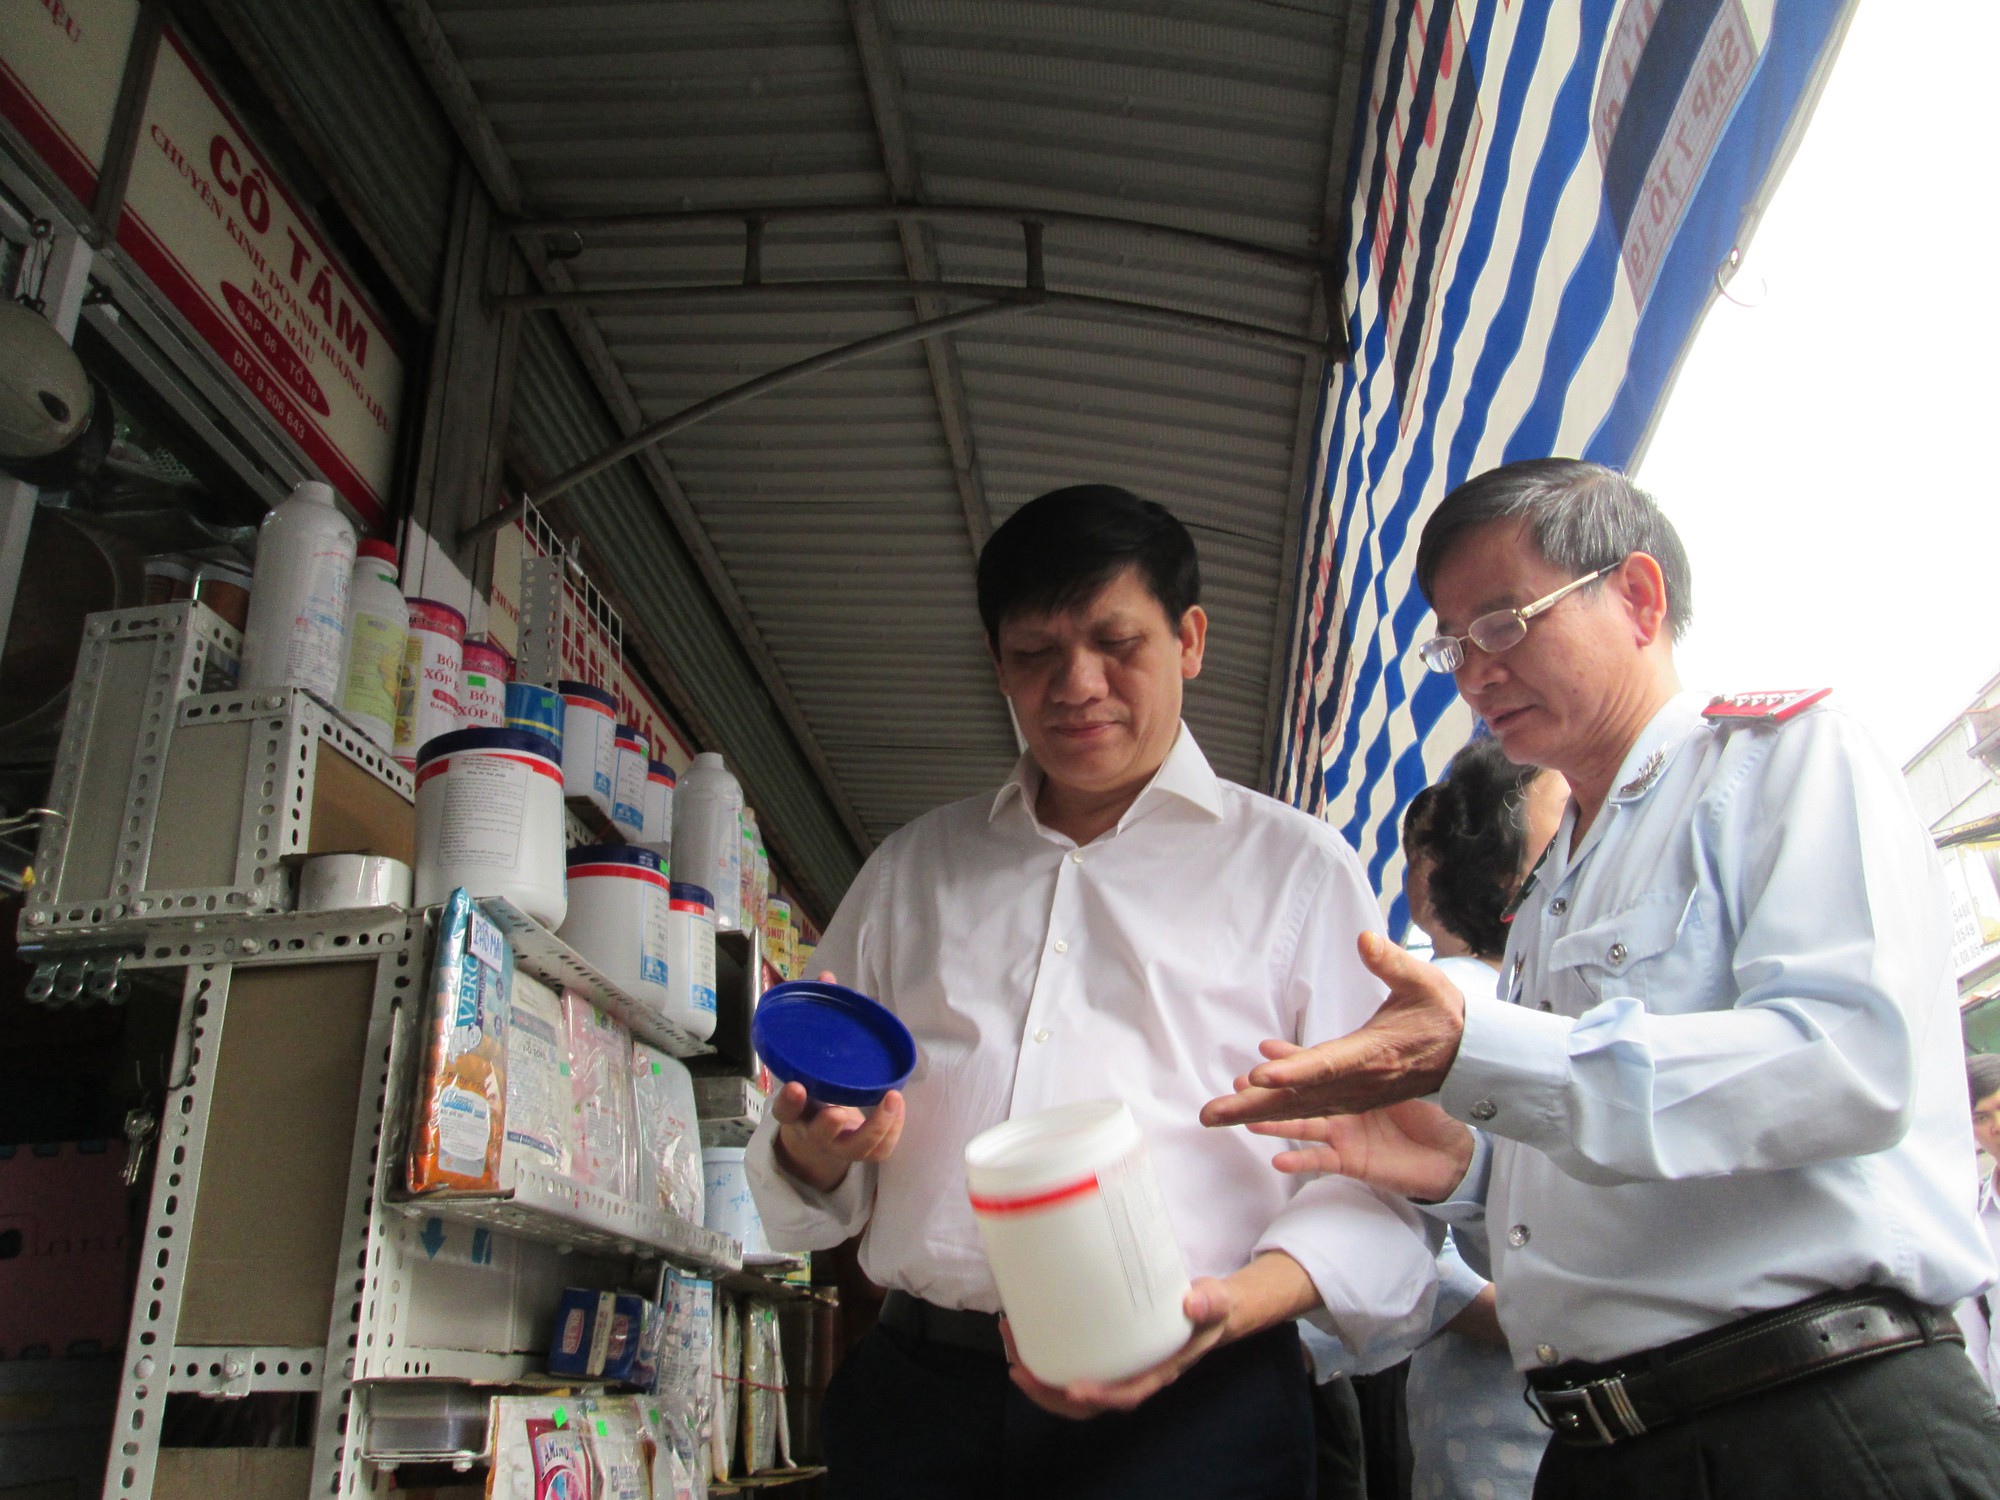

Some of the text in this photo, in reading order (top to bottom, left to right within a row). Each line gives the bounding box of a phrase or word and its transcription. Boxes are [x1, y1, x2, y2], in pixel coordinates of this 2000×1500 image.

[151, 125, 224, 220] CHUYÊN
[226, 216, 266, 275] KINH
[268, 269, 318, 338] DOANH
[210, 135, 368, 369] CÔ TÁM
[252, 278, 282, 322] BỘT
[236, 299, 262, 329] SẠP
[263, 332, 277, 353] 06
[256, 376, 264, 391] 9
[424, 668, 452, 686] XỐP
[458, 703, 488, 719] XỐP
[471, 690, 496, 706] BỘT
